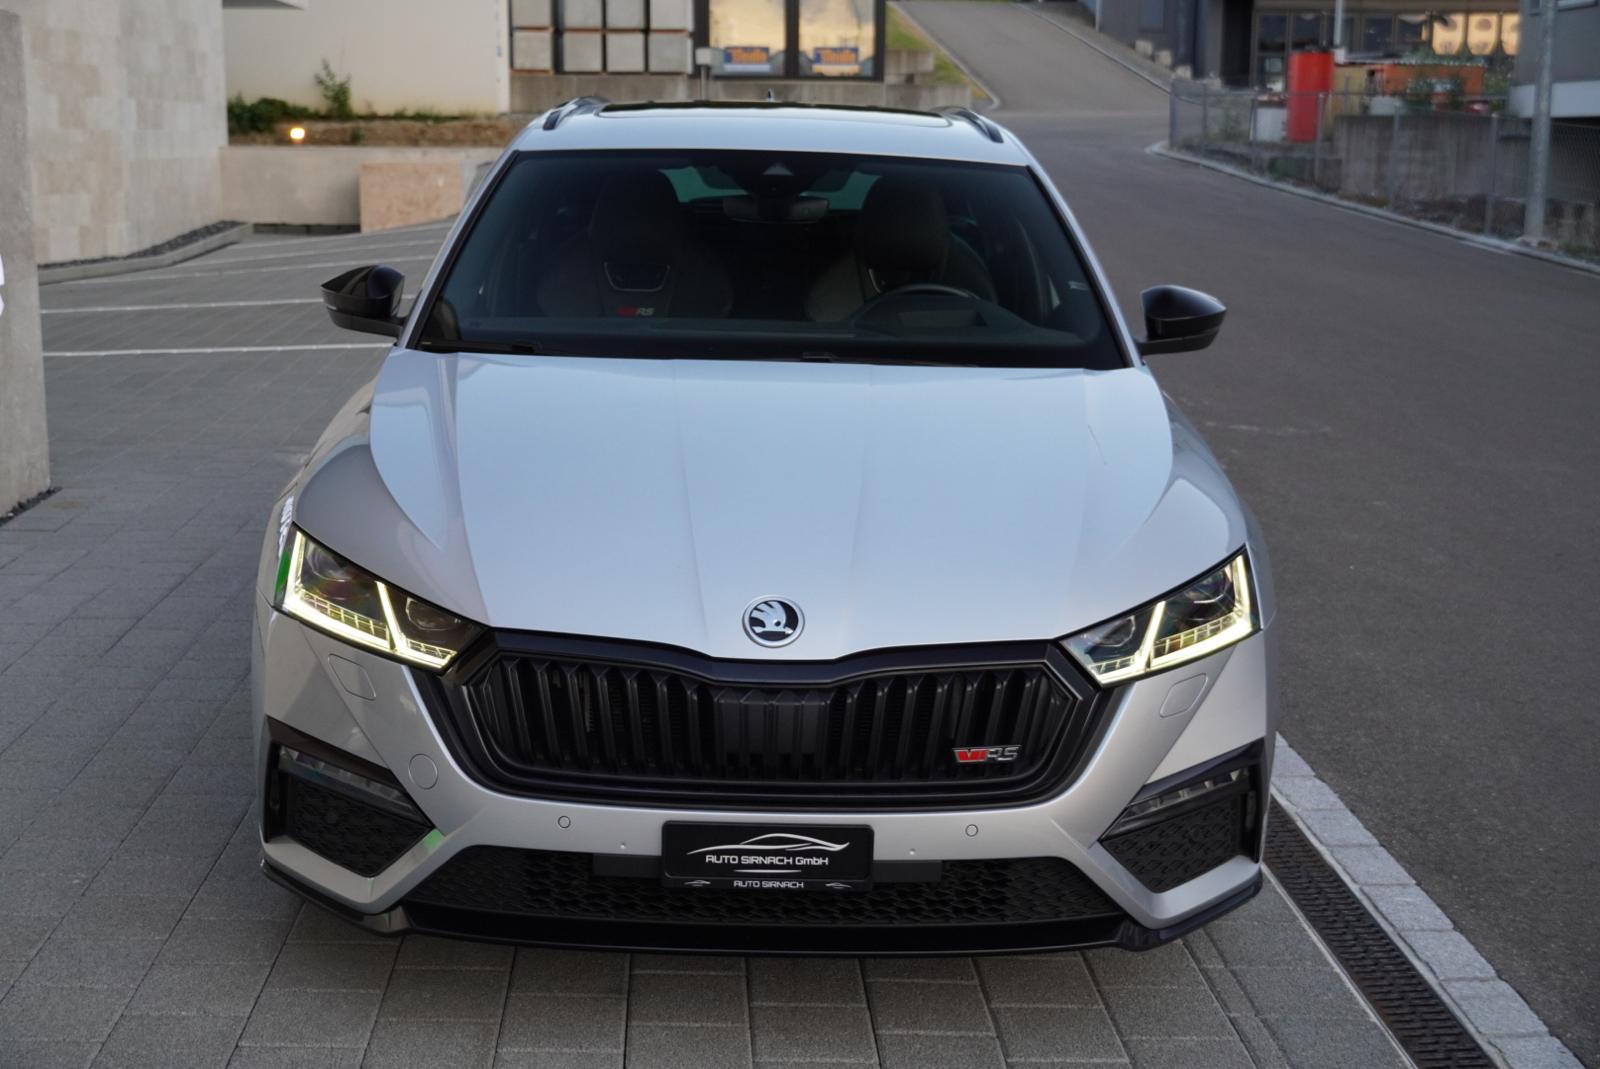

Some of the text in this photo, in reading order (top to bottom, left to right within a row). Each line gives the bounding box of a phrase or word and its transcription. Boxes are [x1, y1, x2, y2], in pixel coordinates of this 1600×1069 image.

[705, 854, 829, 866] AUTO SIRNACH GmbH
[733, 880, 804, 889] AUTO SIRNACH
